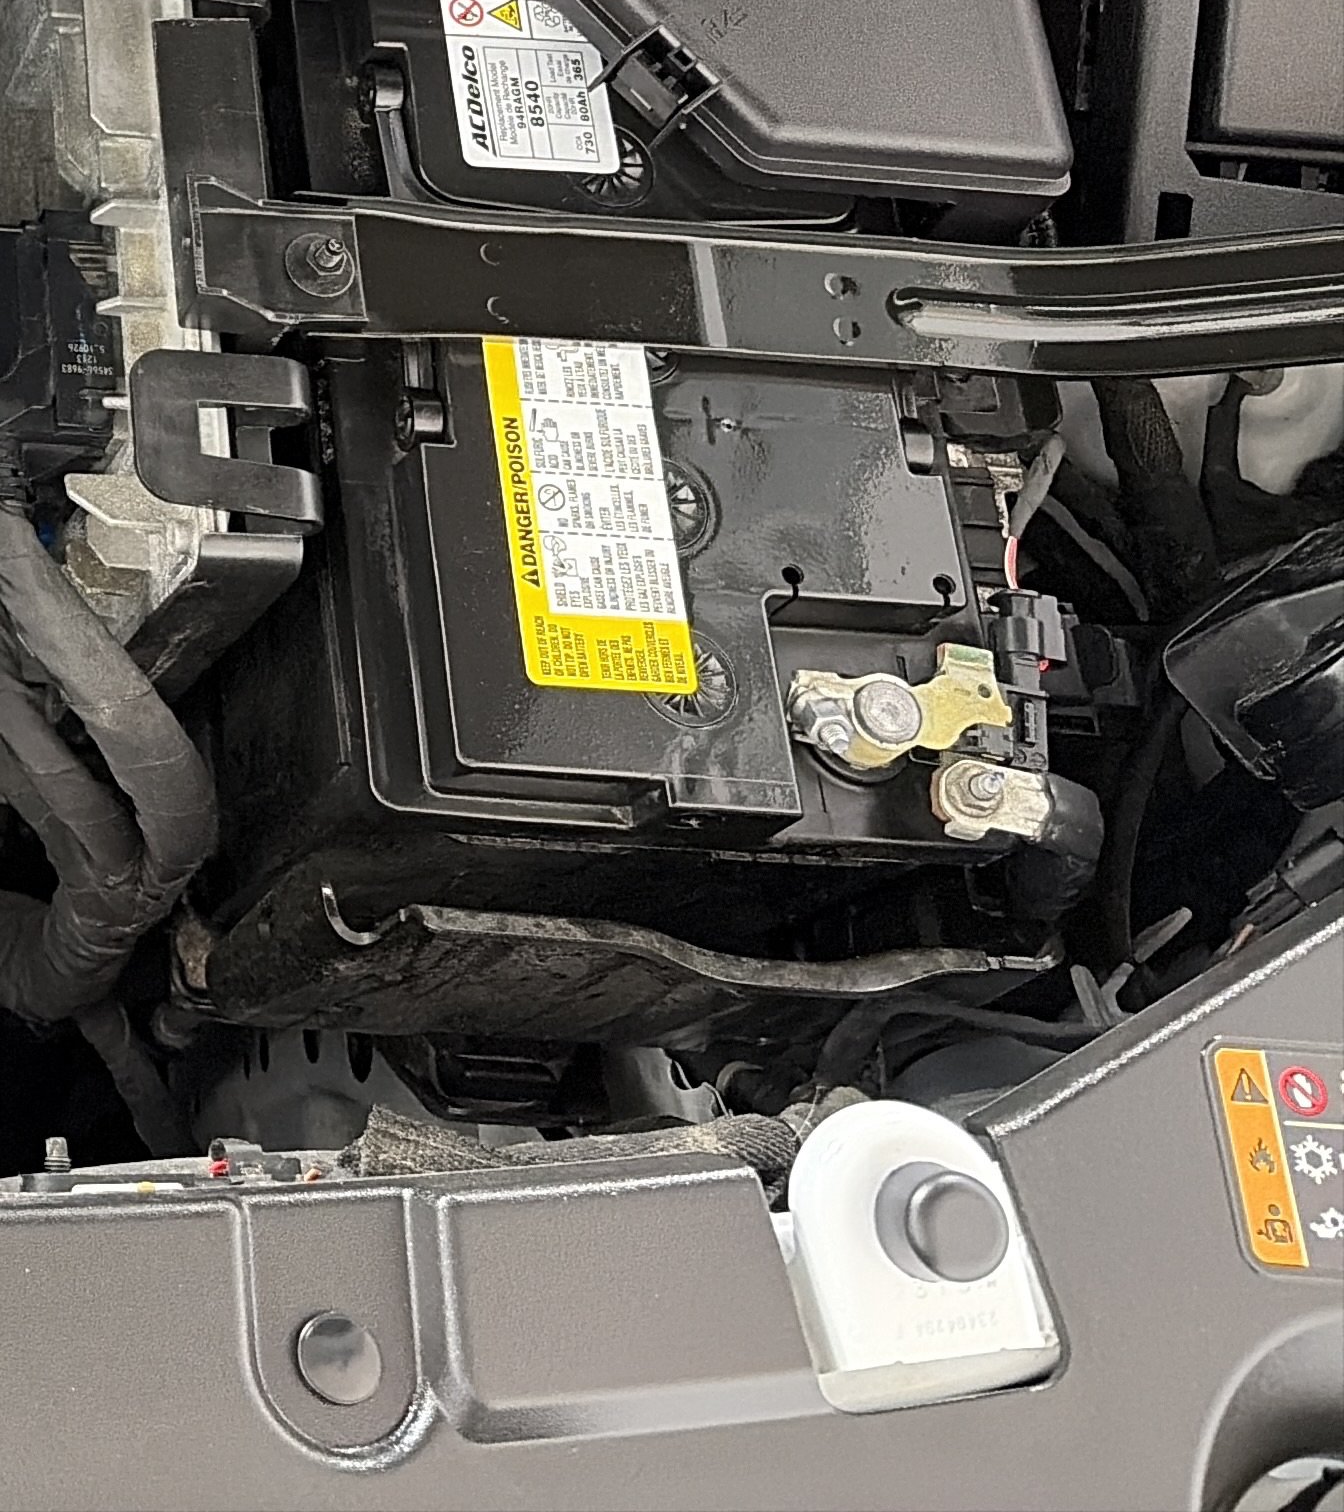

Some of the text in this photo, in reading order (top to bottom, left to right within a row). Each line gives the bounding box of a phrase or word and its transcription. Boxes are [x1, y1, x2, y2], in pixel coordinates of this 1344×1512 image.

[499, 60, 508, 100] Rechange
[571, 59, 583, 81] 365
[461, 45, 489, 152] ACDelco
[488, 62, 508, 141] Replacement Model
[506, 103, 513, 113] de
[510, 77, 526, 129] 94RAGM
[525, 80, 544, 127] 8540
[576, 91, 590, 121] 80Ah
[583, 132, 595, 154] 730
[502, 416, 537, 567] DANGER/POISON
[536, 637, 547, 645] OF
[560, 627, 571, 639] NOT
[563, 641, 573, 649] DO
[538, 647, 549, 658] OUT
